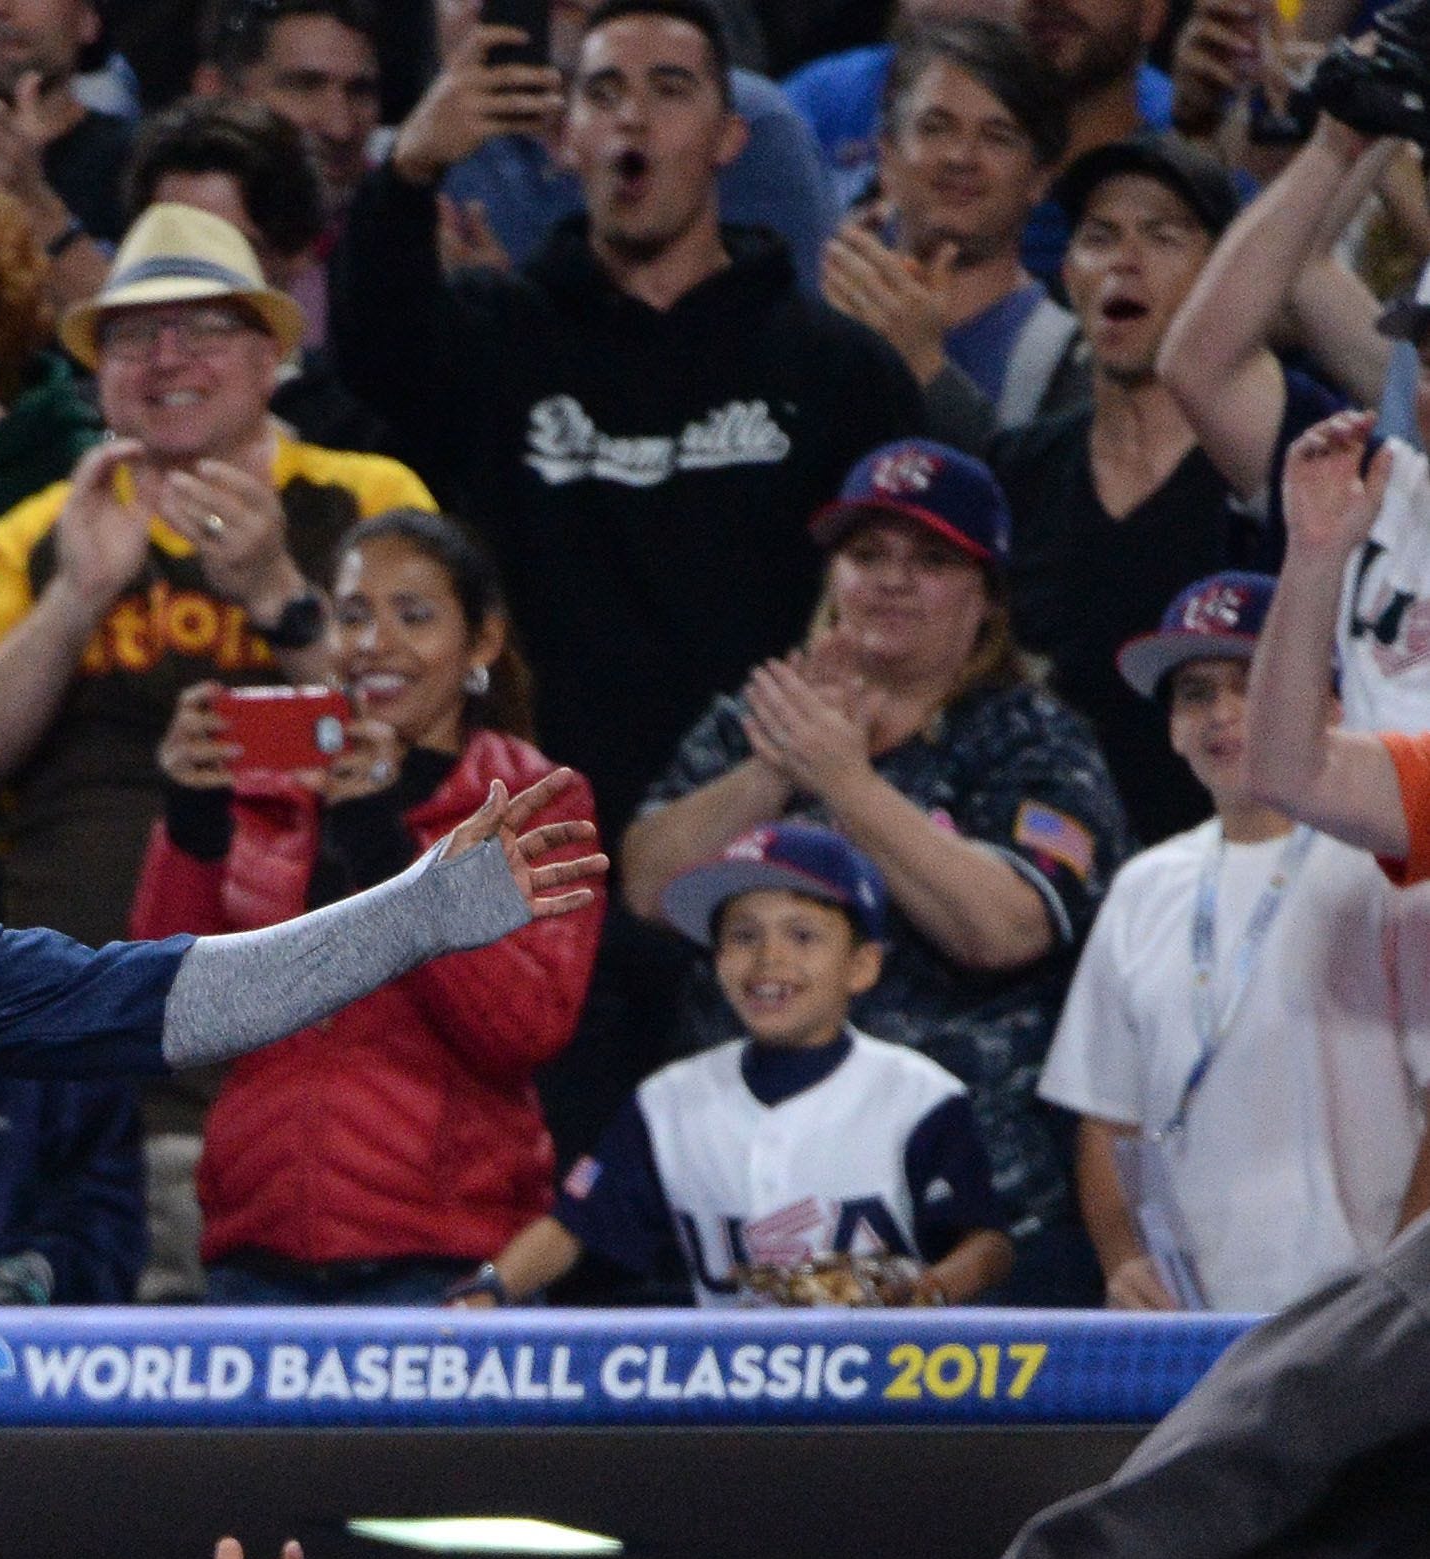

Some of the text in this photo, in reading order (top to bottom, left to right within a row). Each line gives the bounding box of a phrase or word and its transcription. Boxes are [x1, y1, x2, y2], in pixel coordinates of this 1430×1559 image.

[24, 1343, 1048, 1401] WORLD BASEBALL CLASSIC 2017
